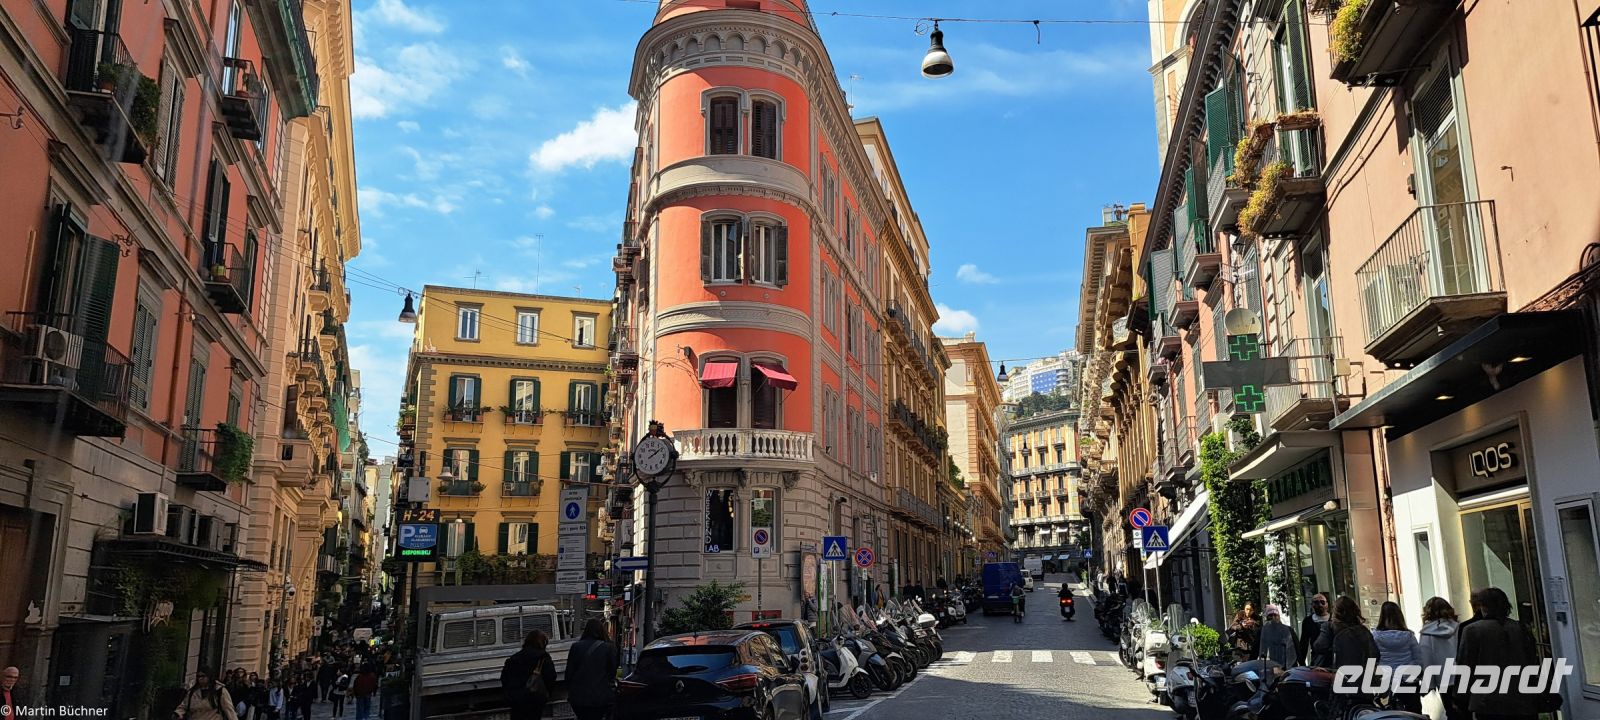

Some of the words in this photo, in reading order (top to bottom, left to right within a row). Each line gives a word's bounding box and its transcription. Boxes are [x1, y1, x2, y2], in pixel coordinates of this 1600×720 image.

[1468, 442, 1512, 478] IQOS
[403, 510, 435, 521] H-24
[705, 490, 714, 544] WEEKEND
[400, 525, 416, 544] P
[704, 544, 720, 553] LAB
